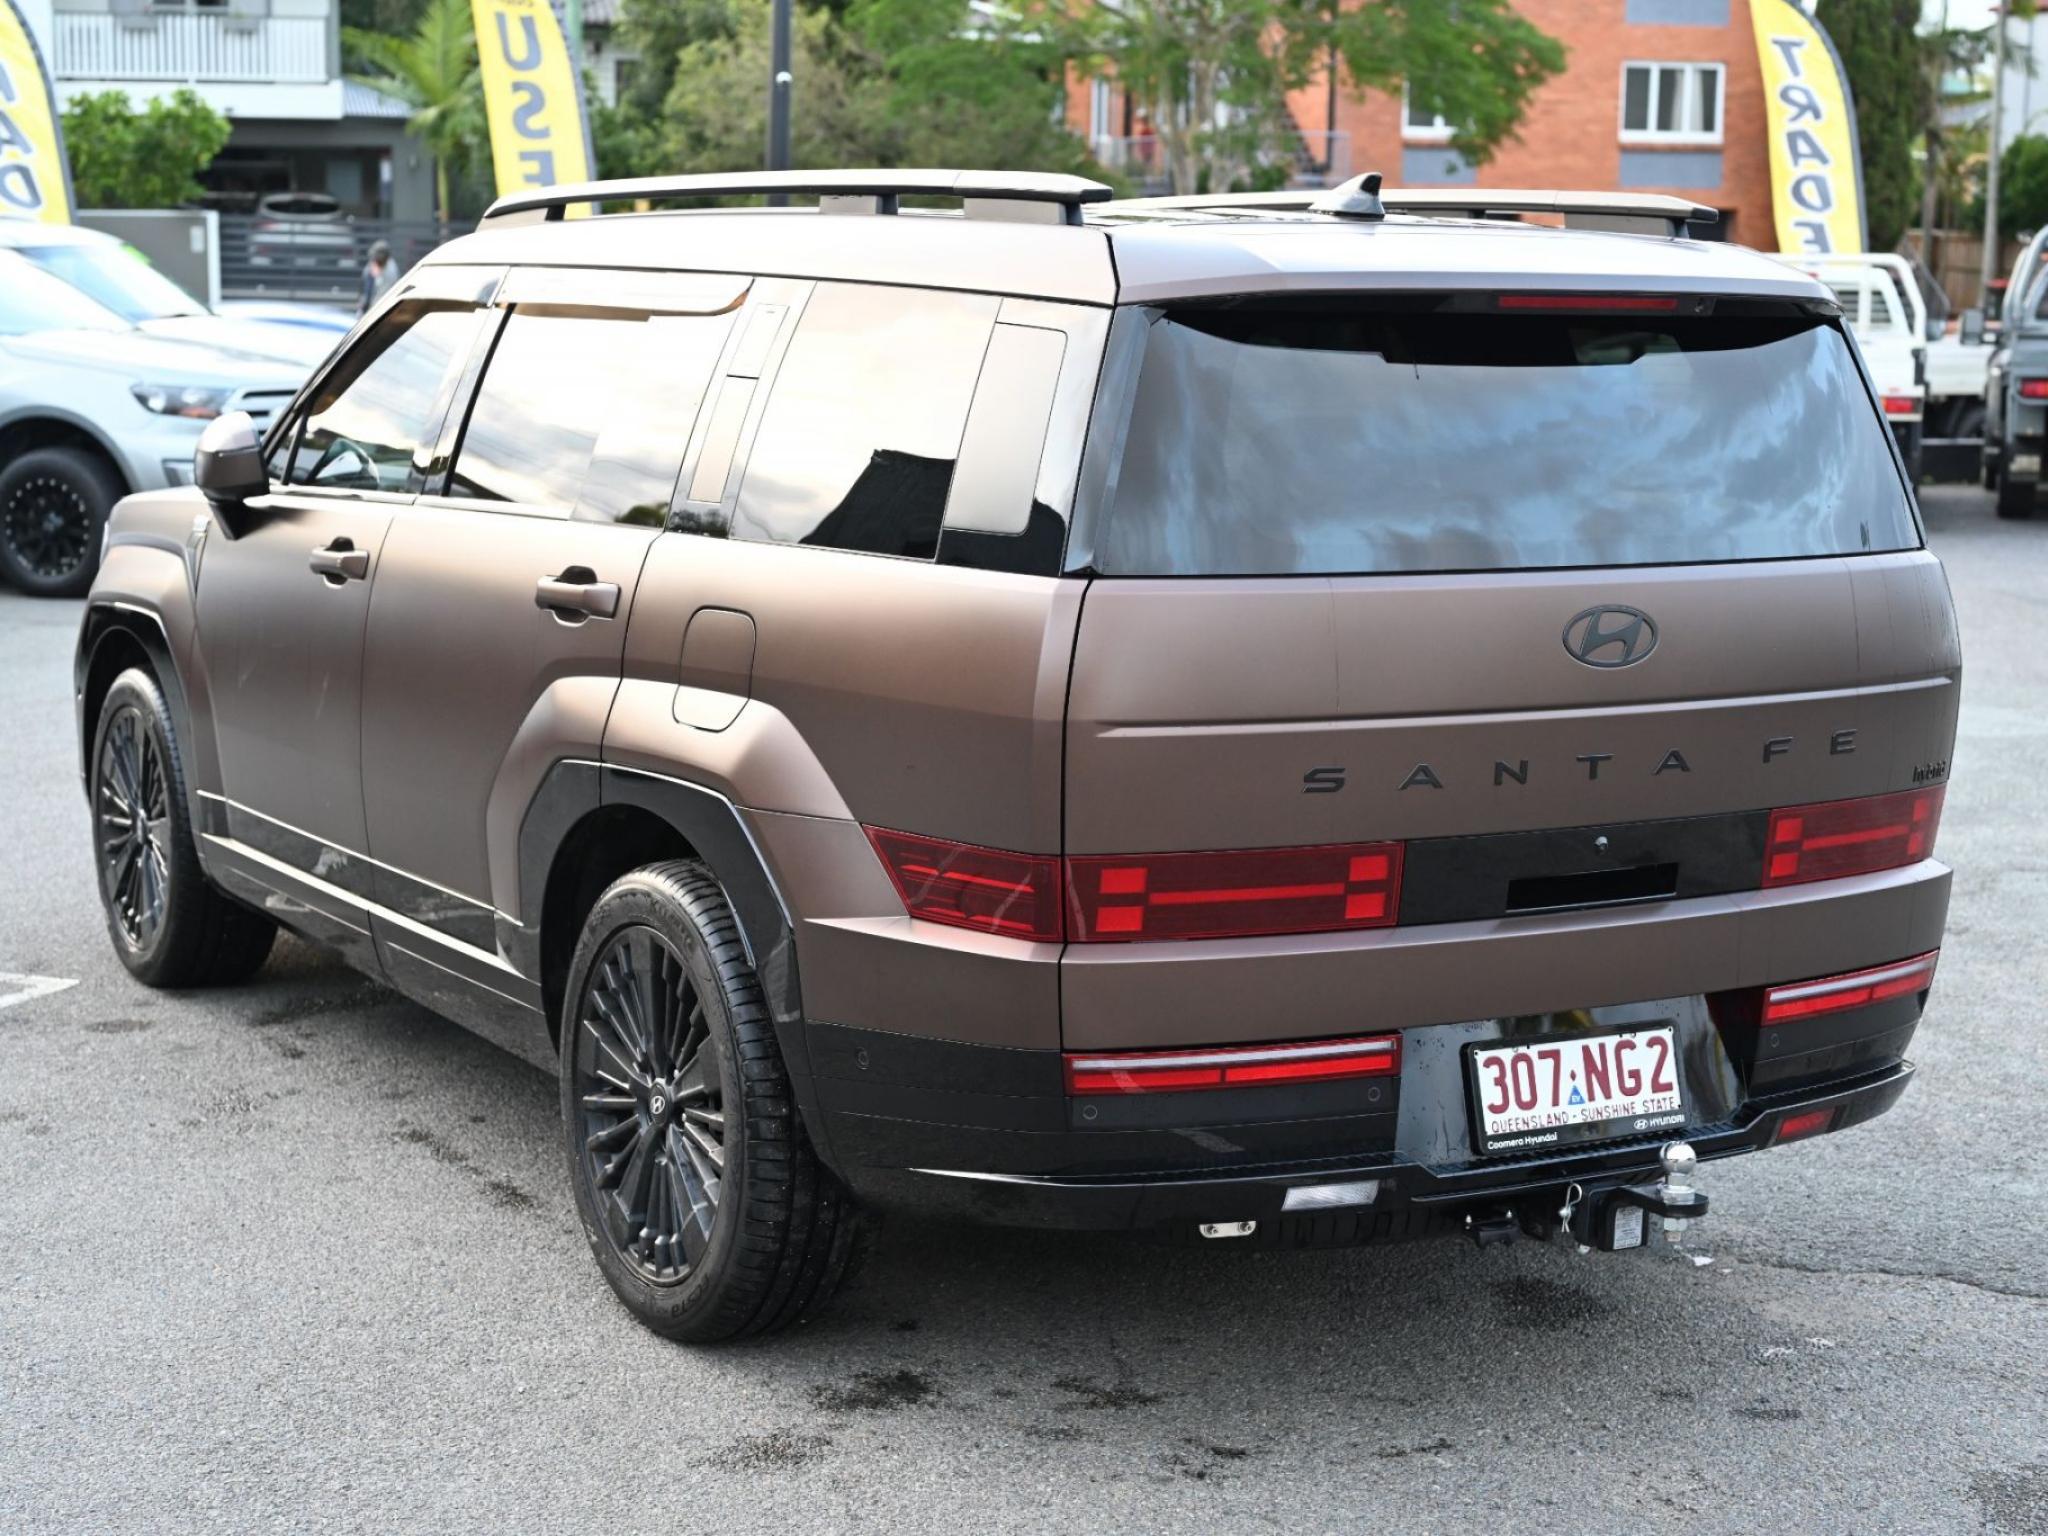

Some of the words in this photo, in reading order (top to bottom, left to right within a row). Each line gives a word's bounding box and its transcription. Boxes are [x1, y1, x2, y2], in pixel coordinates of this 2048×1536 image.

[1302, 747, 1691, 793] SANTA
[1761, 728, 1857, 763] FE
[1482, 1049, 1561, 1115] 307
[1582, 1036, 1674, 1102] NG2
[1491, 1111, 1569, 1133] QUEENSLAND
[1580, 1102, 1637, 1122] SUNSHINE
[1642, 1096, 1675, 1113] STATE
[1487, 1138, 1524, 1150] Coomera
[1524, 1131, 1558, 1146] Hyundai
